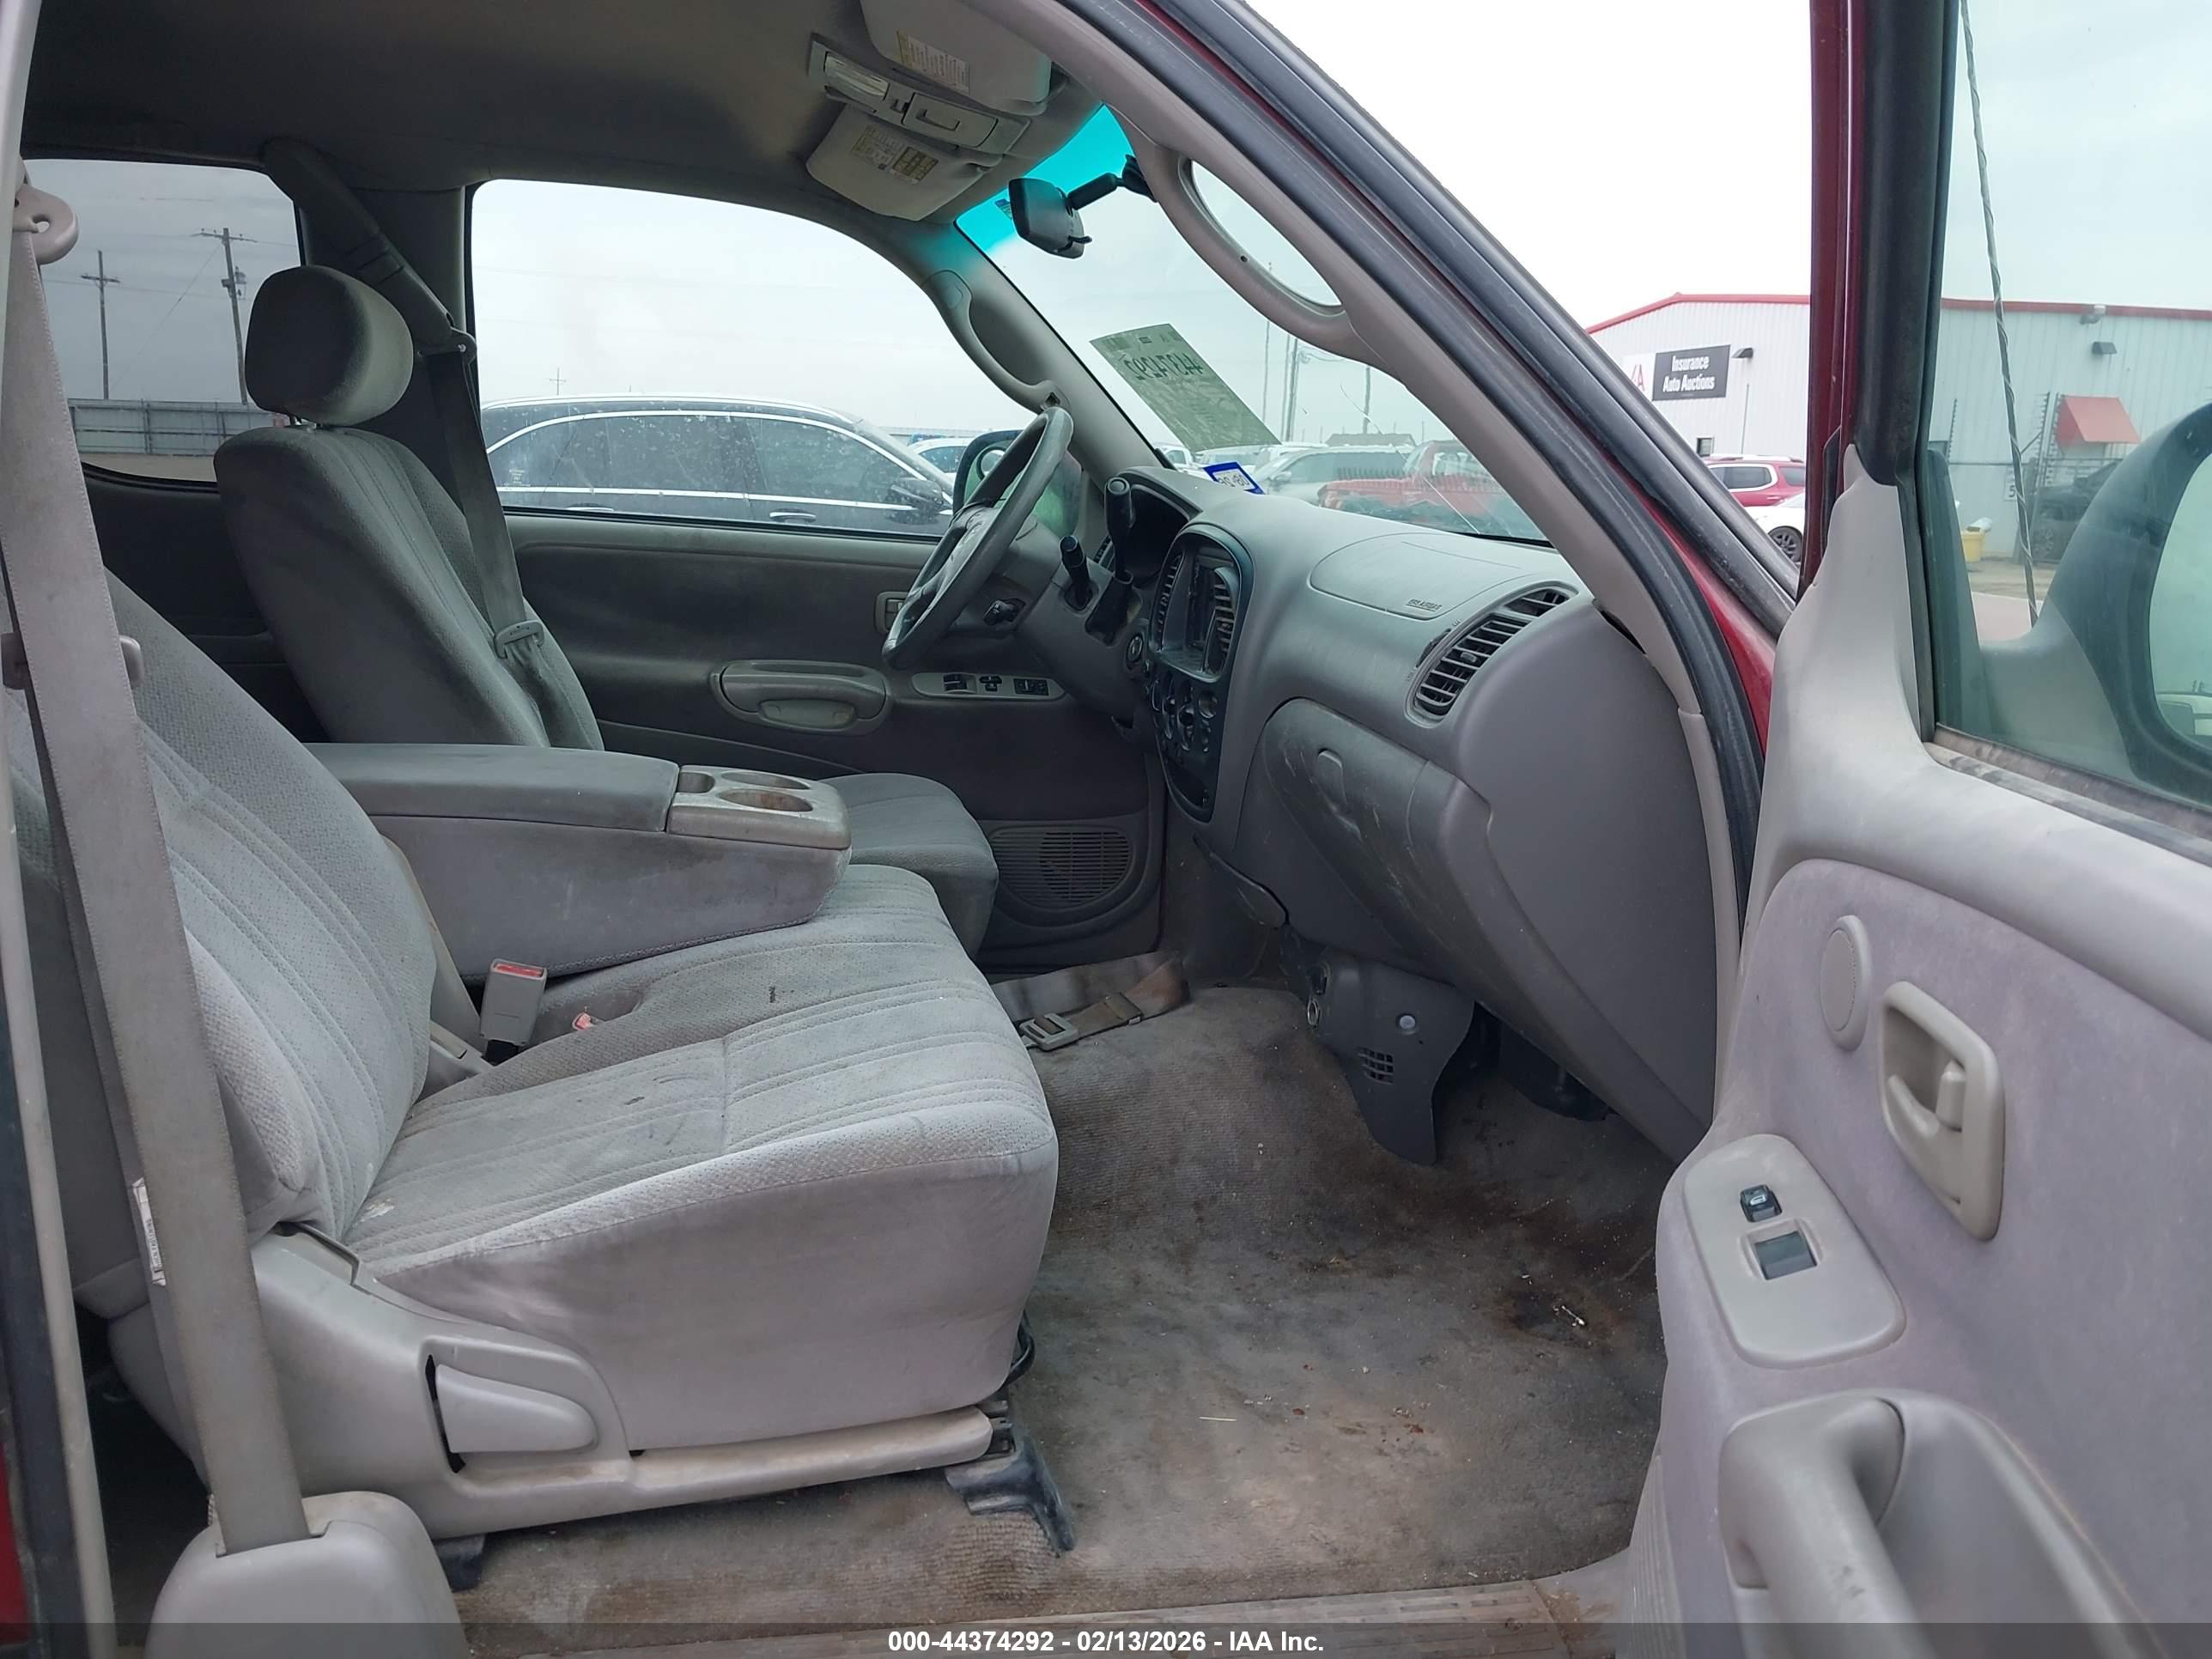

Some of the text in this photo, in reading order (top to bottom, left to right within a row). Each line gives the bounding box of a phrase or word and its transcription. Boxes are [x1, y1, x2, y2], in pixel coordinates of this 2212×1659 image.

[1670, 355, 1710, 372] Insurance
[1662, 374, 1716, 392] Auto Auctions
